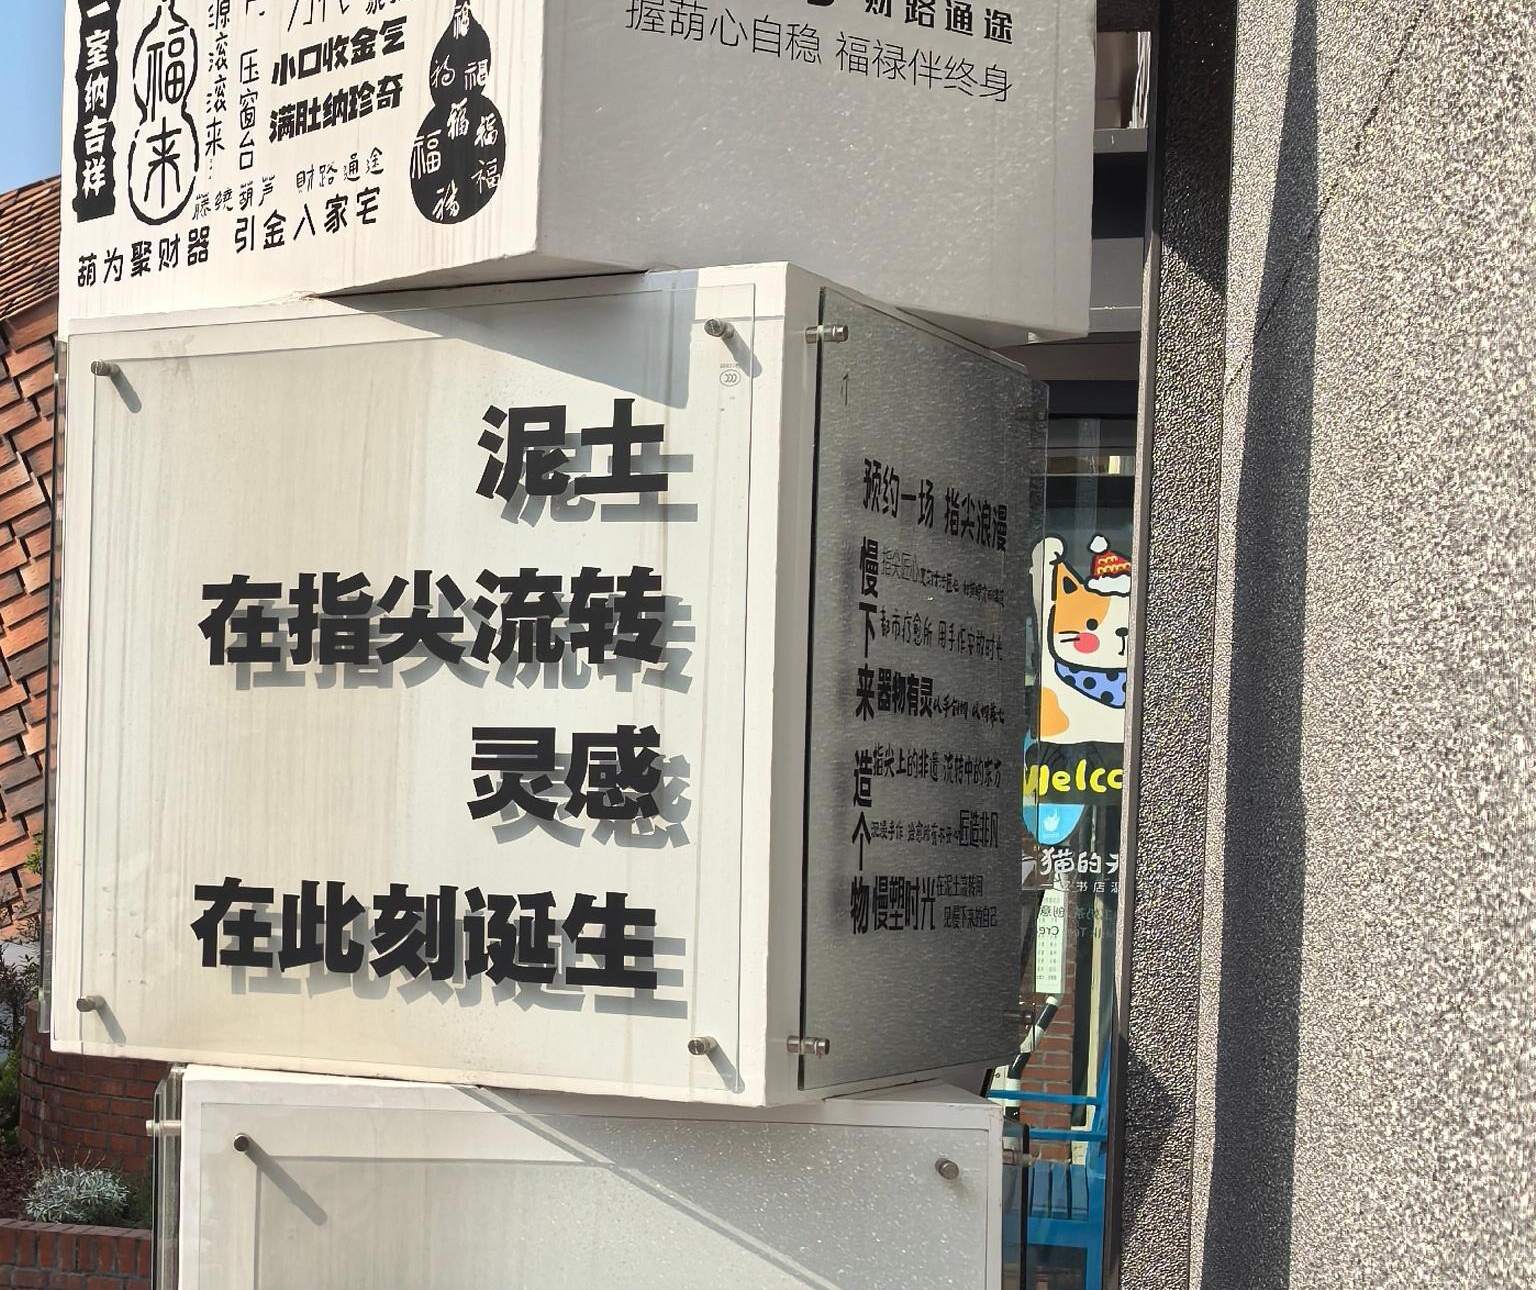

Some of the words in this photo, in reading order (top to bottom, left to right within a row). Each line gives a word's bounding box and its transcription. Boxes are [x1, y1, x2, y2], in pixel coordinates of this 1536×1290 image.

[81, 0, 111, 199] 一室纳吉祥
[268, 73, 404, 144] 满肚纳珍奇
[836, 31, 1013, 102] 福禄伴终身
[77, 225, 210, 287] 葫为聚财器
[235, 186, 380, 254] 引金入家宅
[476, 398, 669, 500] 泥土
[863, 458, 934, 529] 预约一场
[944, 486, 1008, 551] 指尖浪漫
[197, 565, 664, 666] 在指尖流转
[877, 667, 934, 718] 器物有灵
[467, 724, 662, 822] 灵感
[190, 876, 658, 990] 在此刻诞生
[873, 875, 936, 931] 慢塑时光
